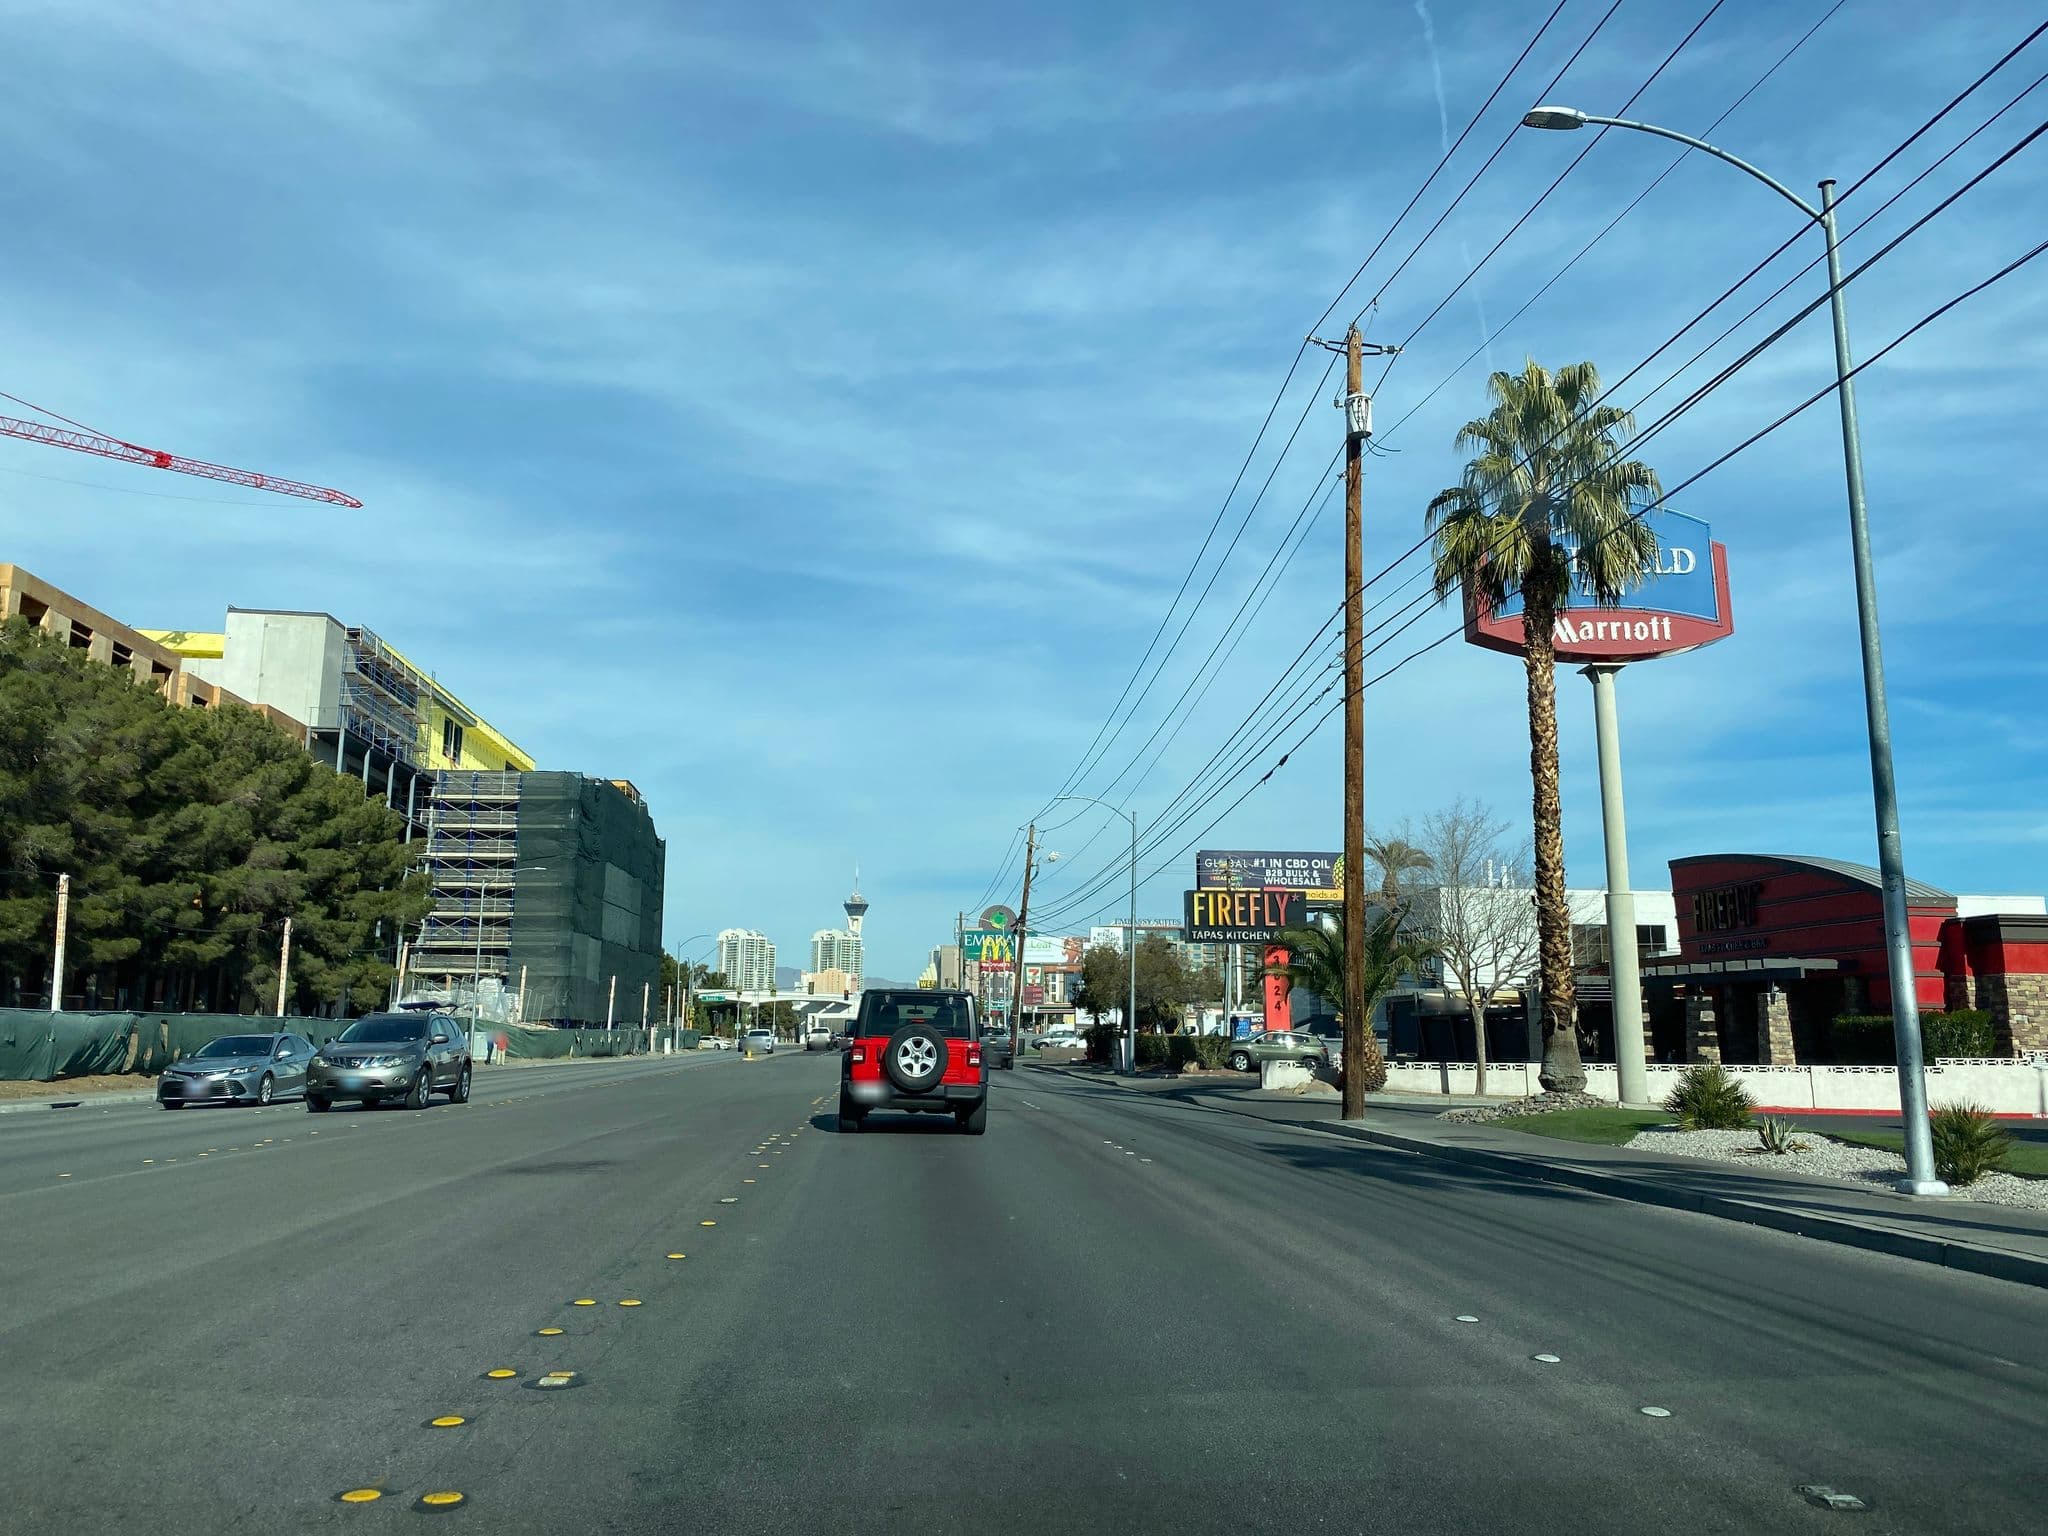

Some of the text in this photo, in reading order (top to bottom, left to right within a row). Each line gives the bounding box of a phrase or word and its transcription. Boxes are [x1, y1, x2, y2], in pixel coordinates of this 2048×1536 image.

[1551, 616, 1672, 643] Marriott
[1253, 859, 1266, 868] #1
[1269, 859, 1282, 868] IN
[1285, 859, 1309, 869] CBD
[1311, 859, 1331, 869] OIL
[1265, 869, 1283, 877] B2B
[1285, 869, 1310, 877] BULK
[1263, 876, 1321, 886] WHOLESALE
[1191, 930, 1224, 940] TAPAS
[1226, 930, 1270, 941] KITCHEN
